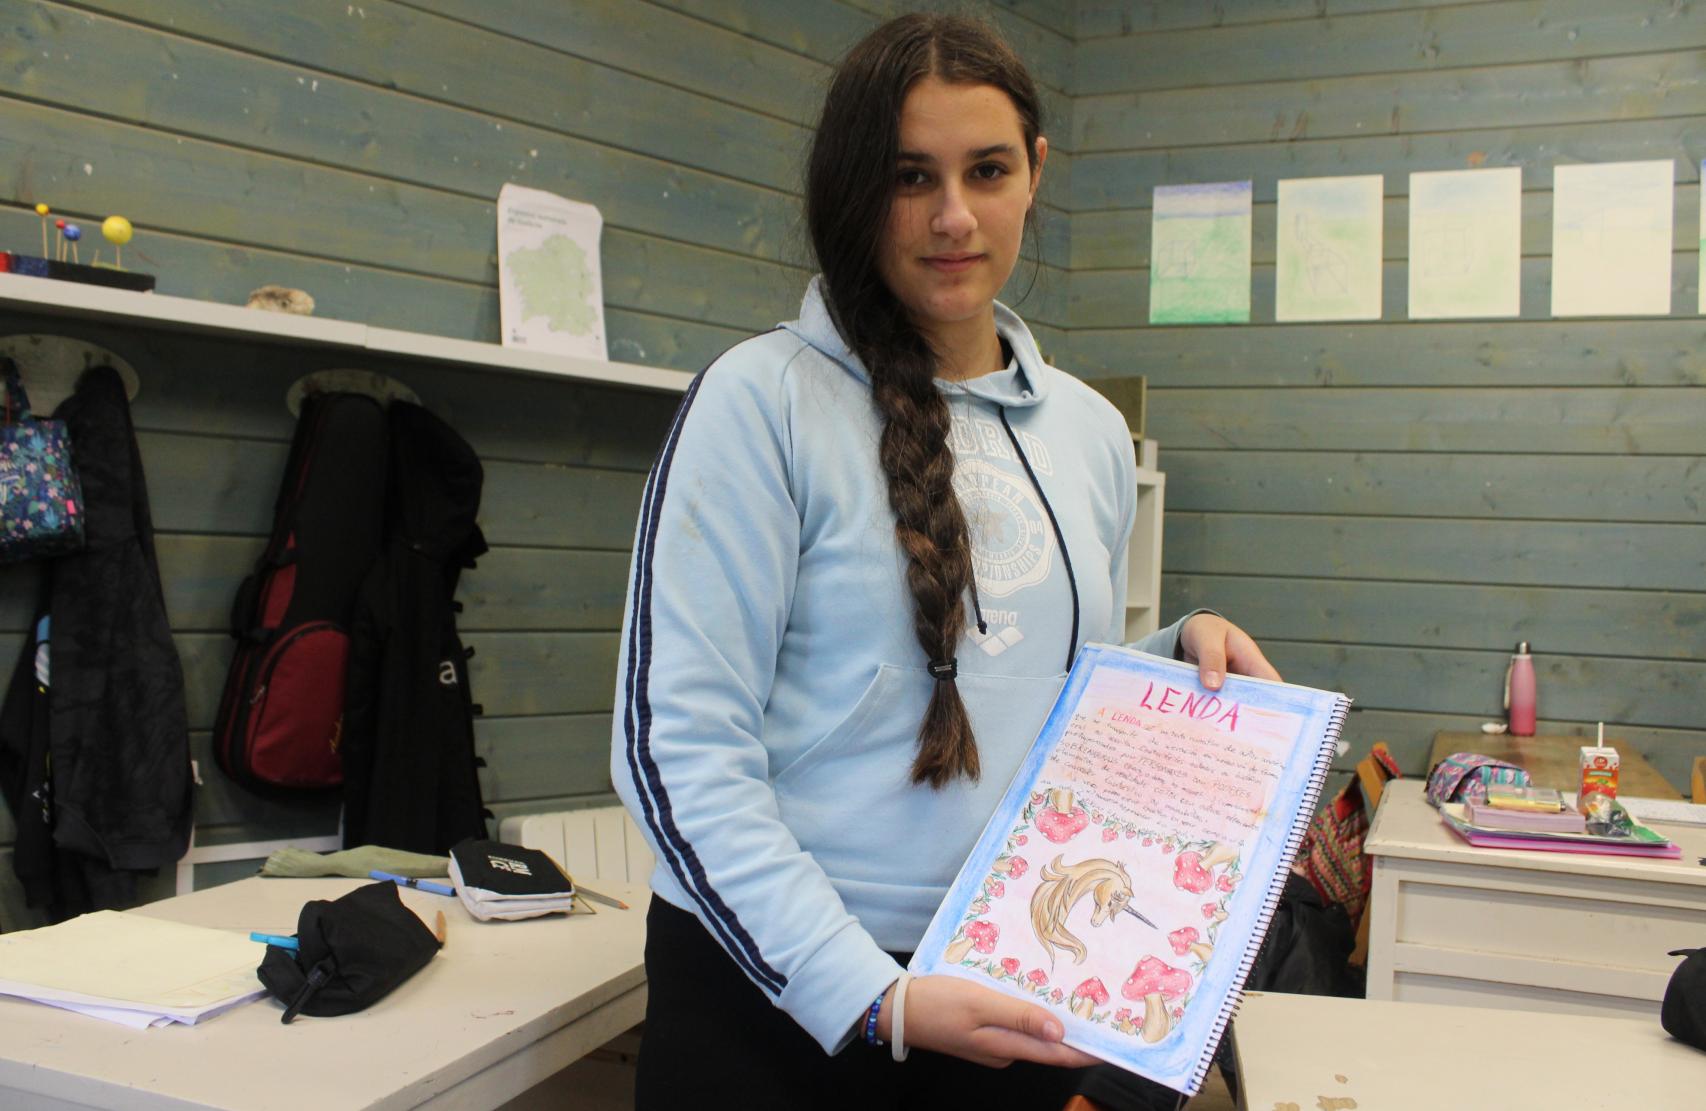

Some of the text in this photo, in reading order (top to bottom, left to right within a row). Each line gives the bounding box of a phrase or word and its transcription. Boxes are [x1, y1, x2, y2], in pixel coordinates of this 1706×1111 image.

[439, 660, 457, 685] a
[1139, 681, 1241, 732] LENDA
[1111, 712, 1141, 727] LENDA
